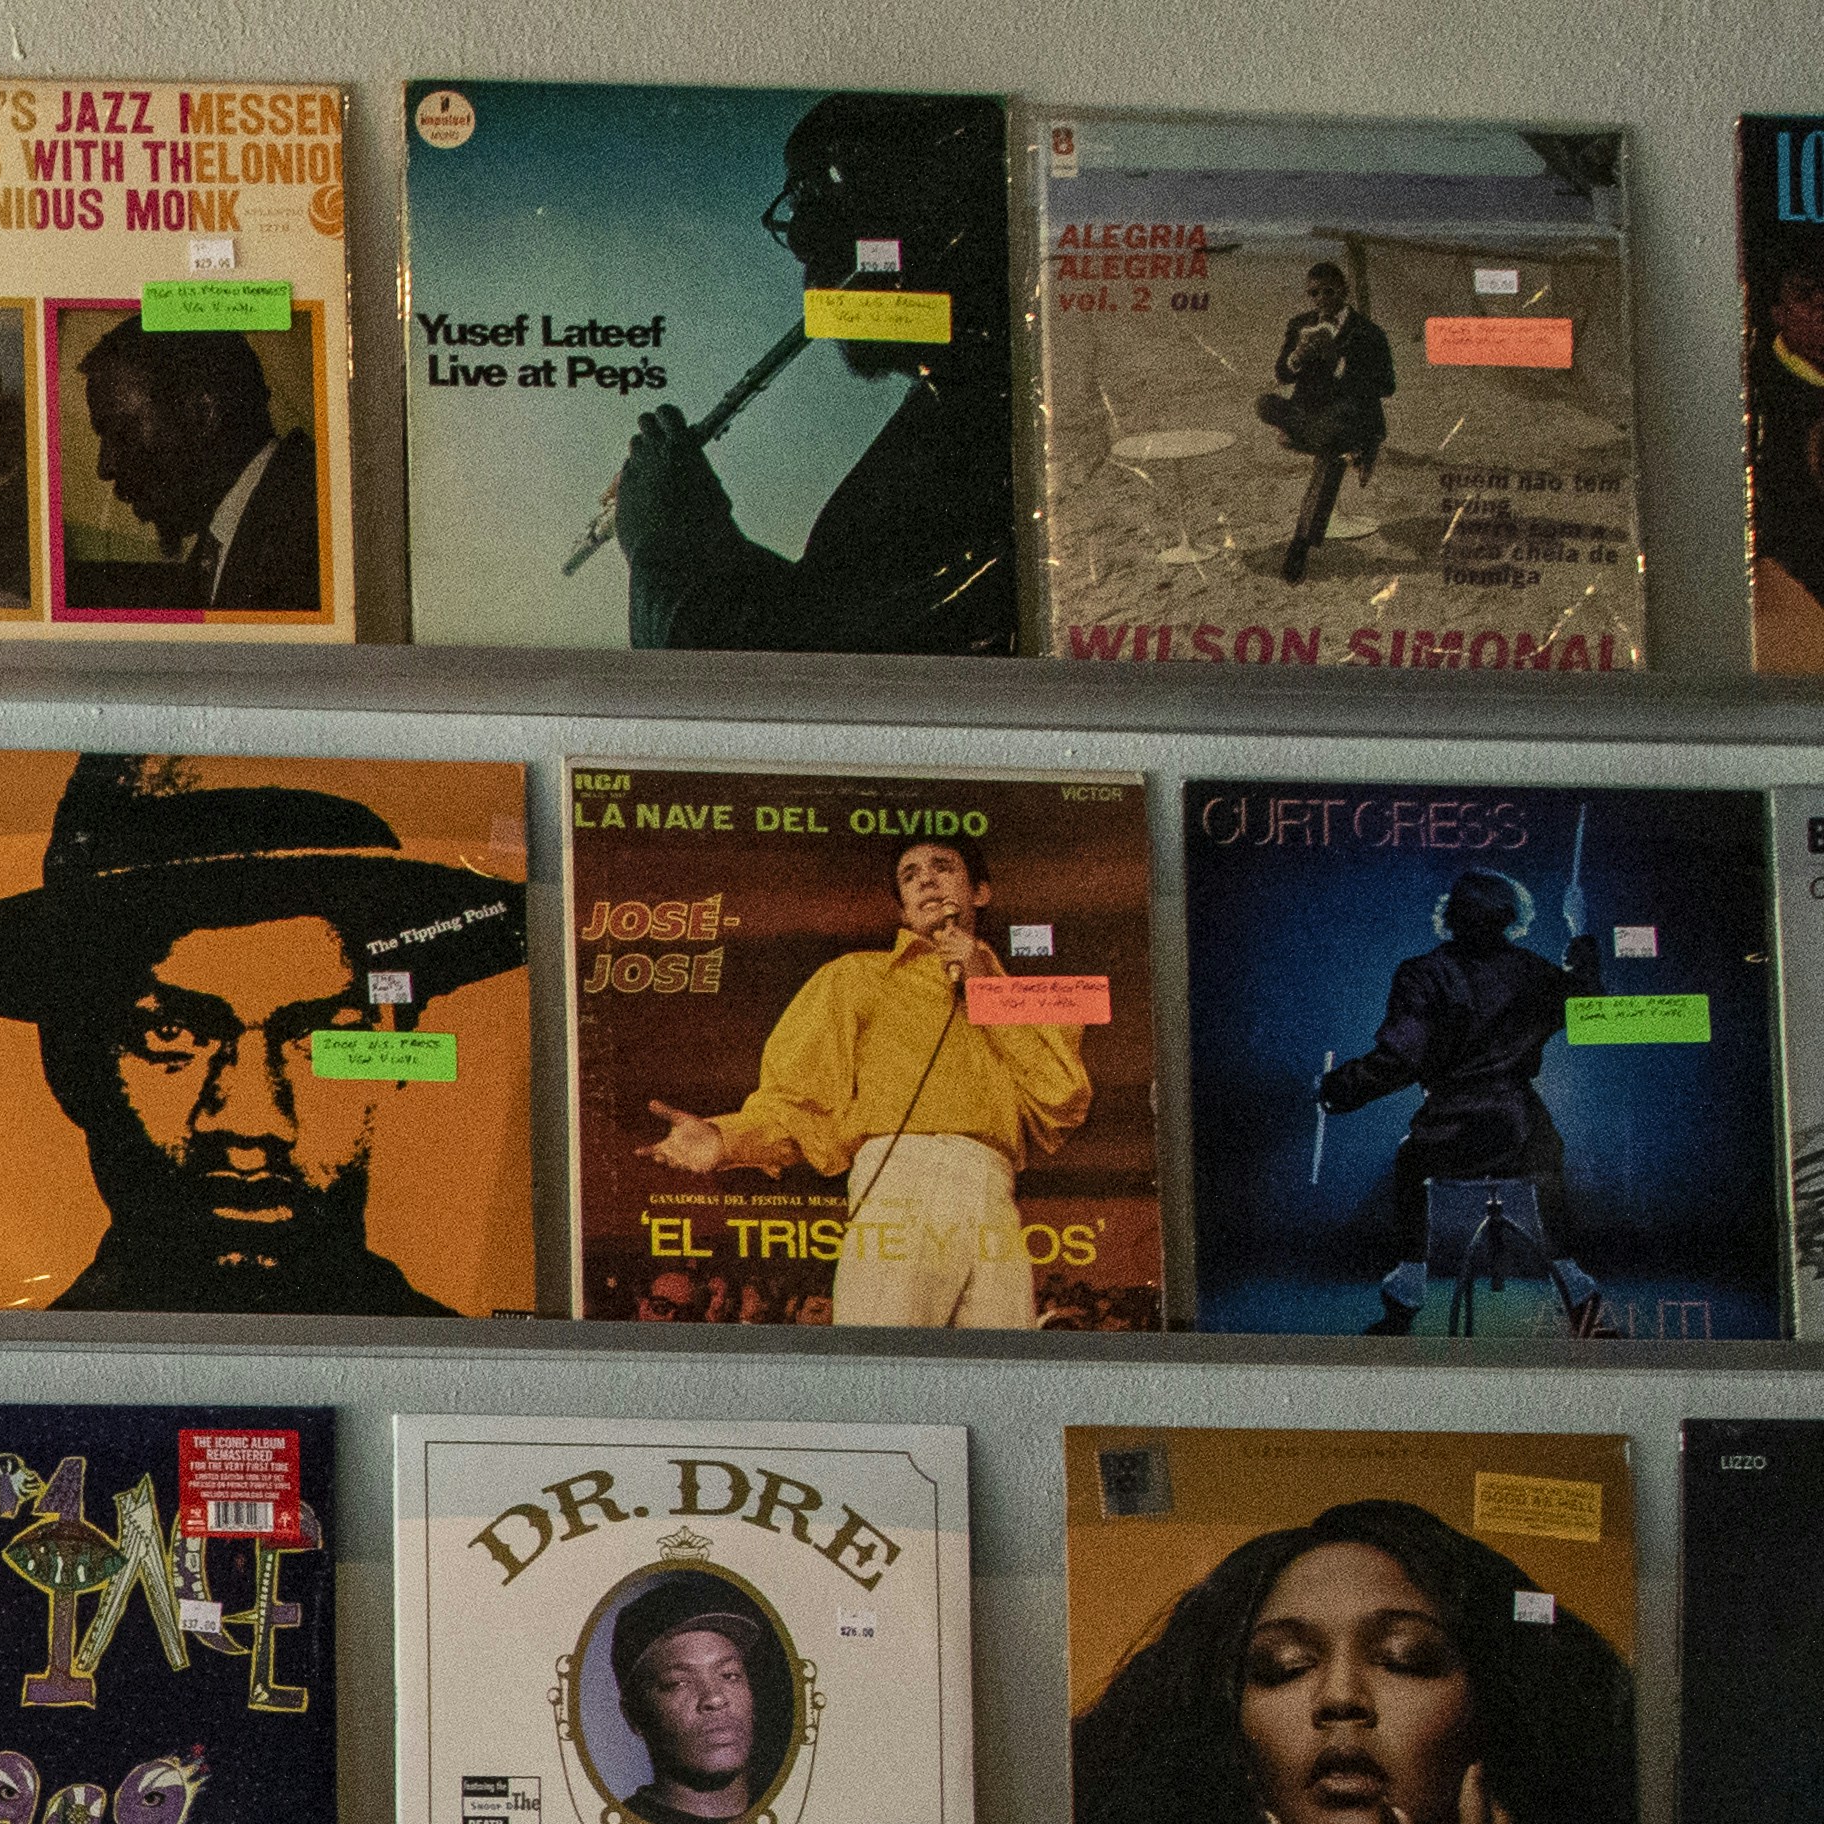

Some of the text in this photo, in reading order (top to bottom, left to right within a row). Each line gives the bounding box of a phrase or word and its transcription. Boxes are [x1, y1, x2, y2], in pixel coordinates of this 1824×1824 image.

[55, 91, 151, 134] JAZZ
[21, 139, 125, 183] WITH
[126, 189, 241, 231] MONK
[418, 314, 666, 348] Yusef Lateef
[429, 356, 667, 395] Live at Pep's
[1068, 625, 1321, 666] WILSON
[574, 802, 989, 838] LA NAVE DEL OLVIDO
[1202, 797, 1528, 850] CURT CRESS
[366, 900, 507, 957] The Tipping Point
[1719, 1454, 1768, 1472] LIZZO
[467, 1458, 902, 1592] DR. DRE
